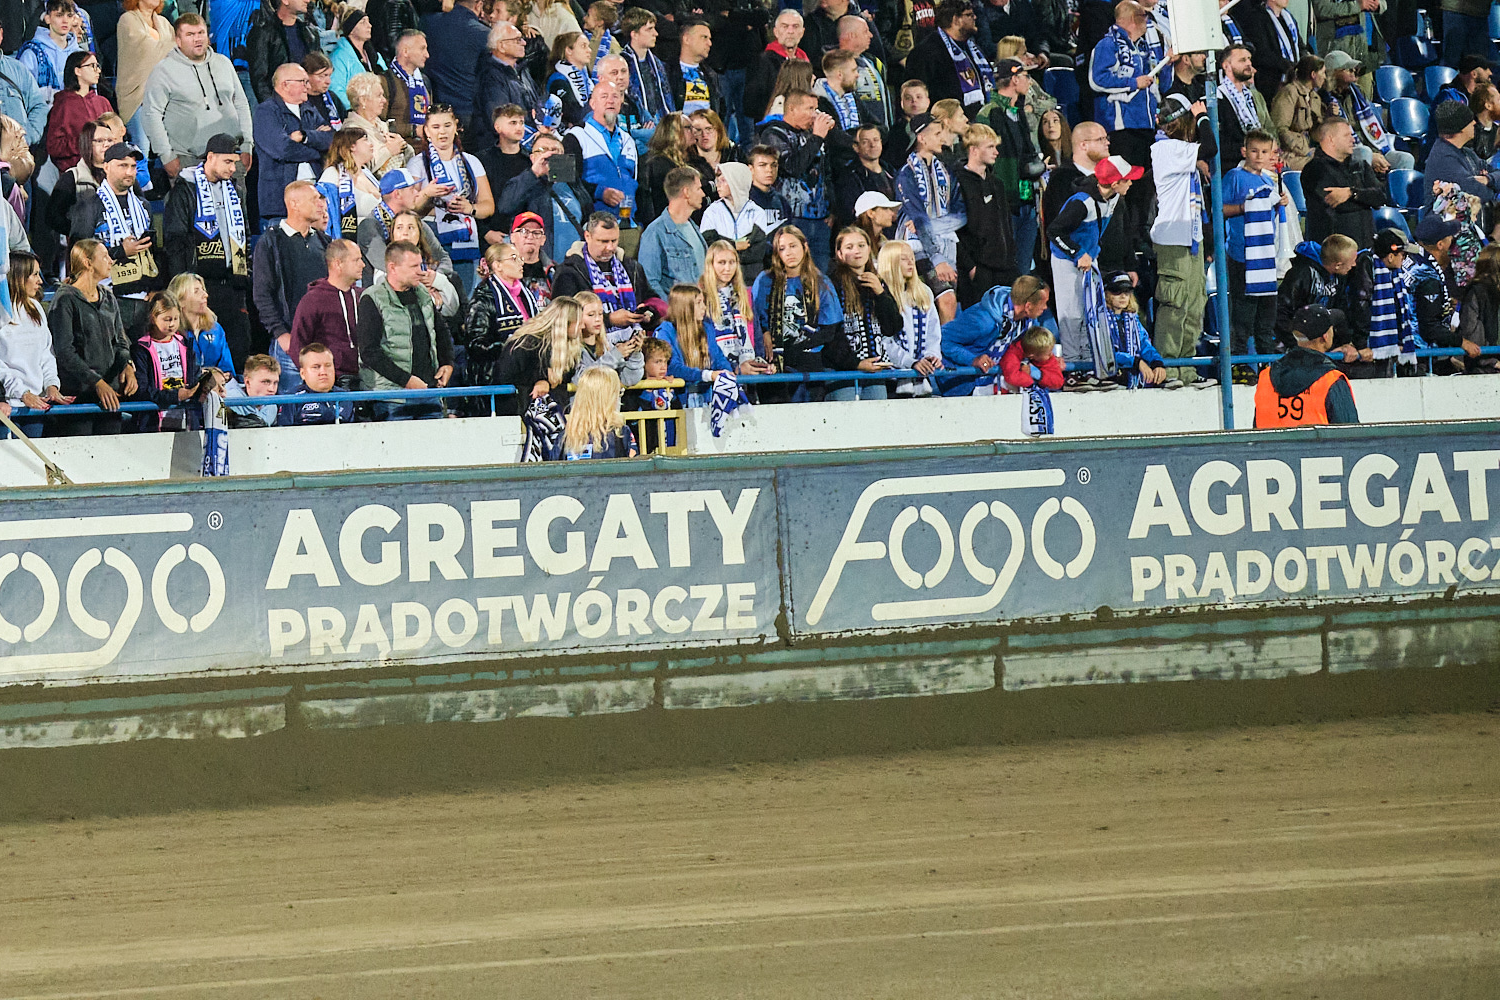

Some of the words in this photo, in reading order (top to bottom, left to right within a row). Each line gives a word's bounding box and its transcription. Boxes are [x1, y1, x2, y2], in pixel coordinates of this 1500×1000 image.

[1277, 396, 1305, 421] 59
[1127, 449, 1500, 540] AGREGAT
[264, 487, 762, 591] AGREGATY
[266, 576, 759, 662] PRĄDOTWÓRCZE
